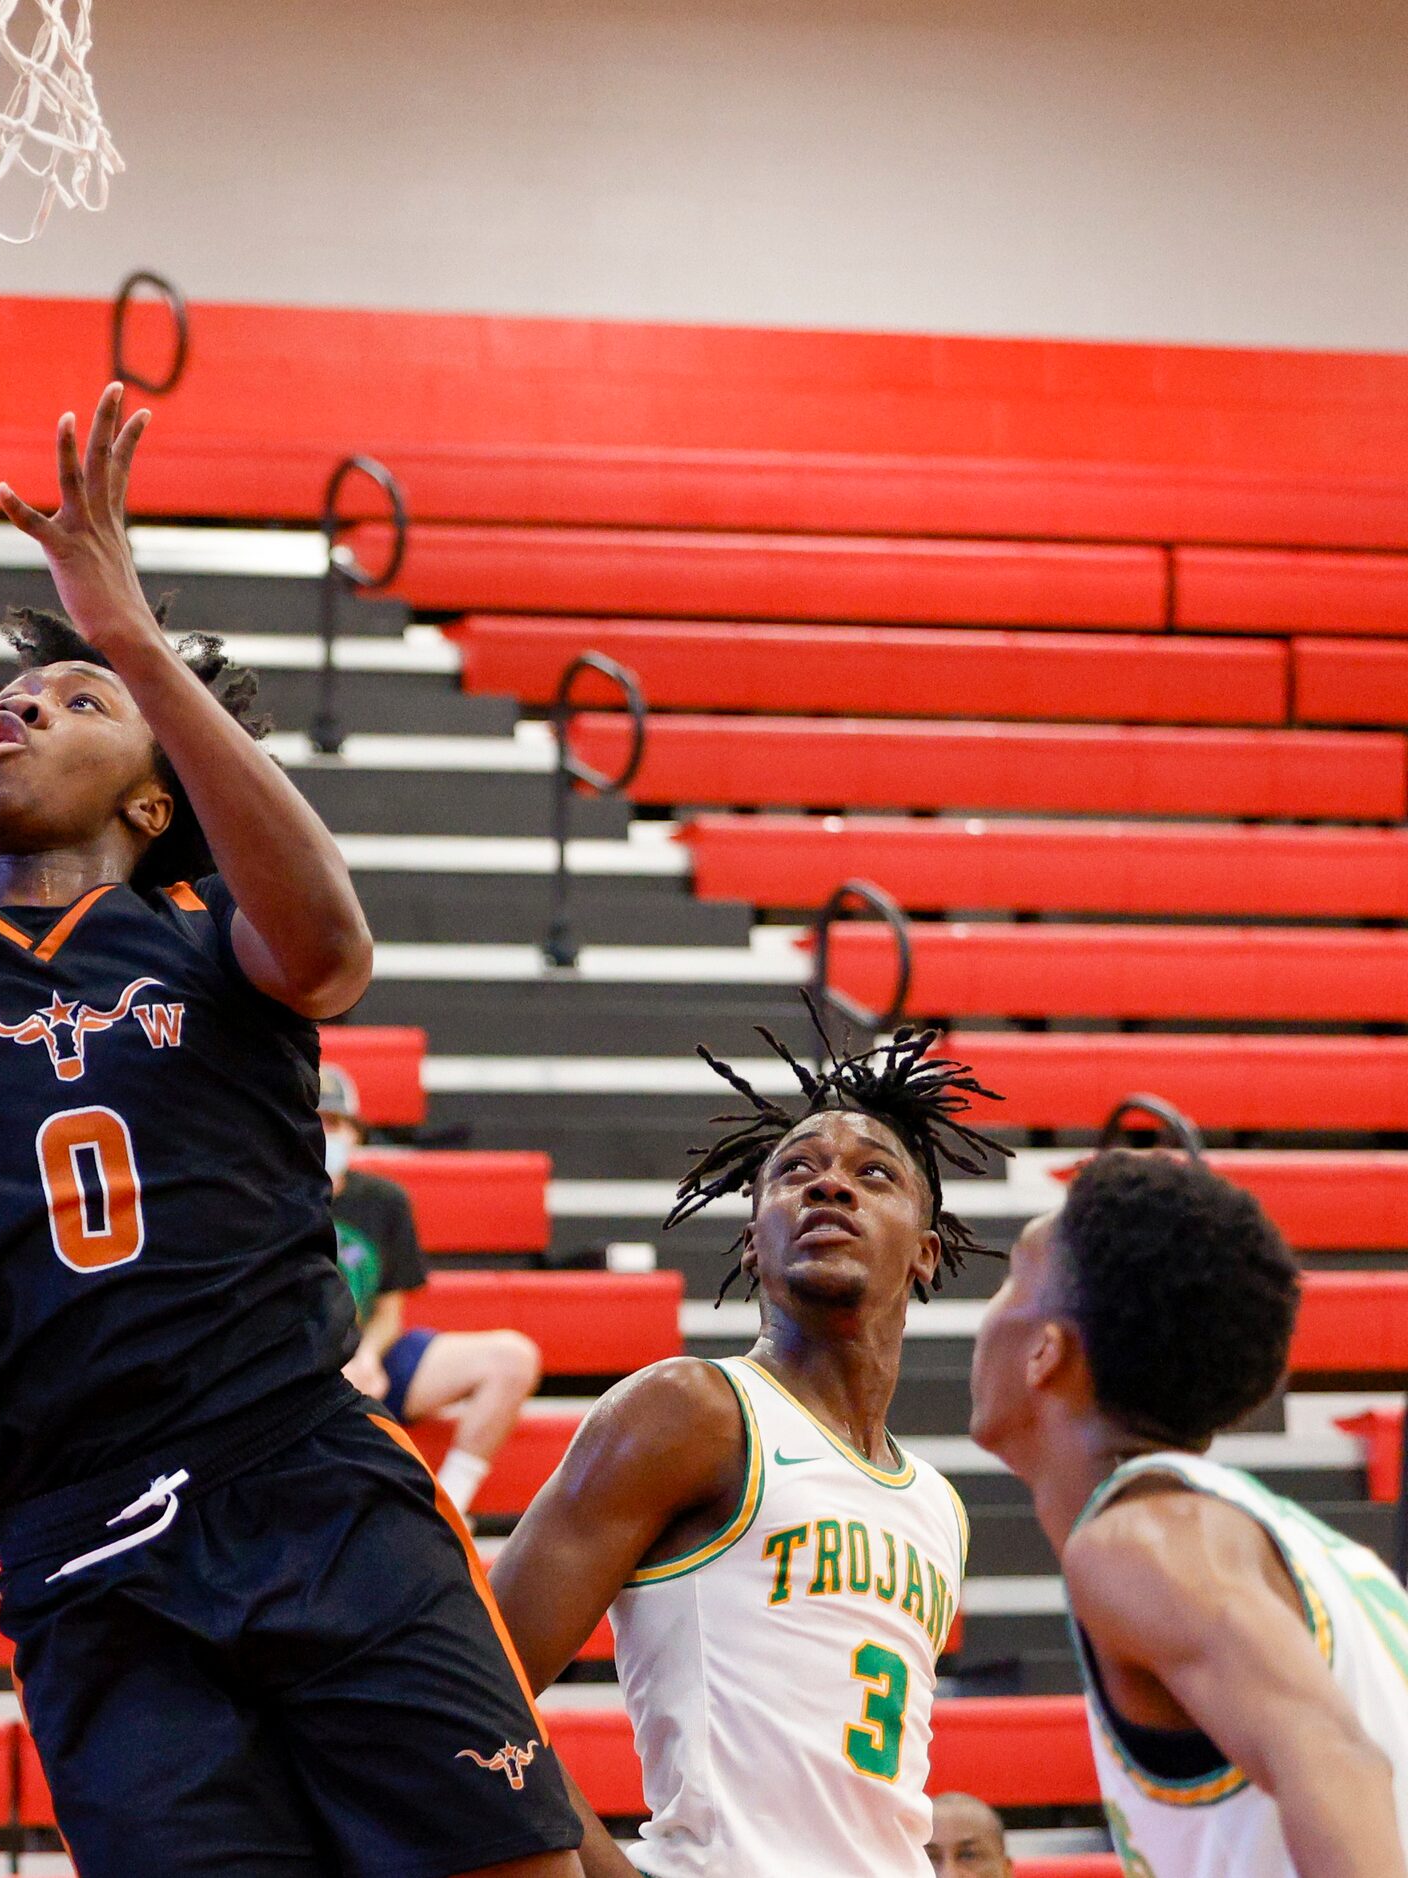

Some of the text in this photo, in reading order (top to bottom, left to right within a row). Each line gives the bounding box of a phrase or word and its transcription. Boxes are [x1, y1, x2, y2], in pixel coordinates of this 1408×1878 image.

[133, 1002, 185, 1049] W
[35, 1105, 145, 1274] 0
[843, 1639, 910, 1784] 3
